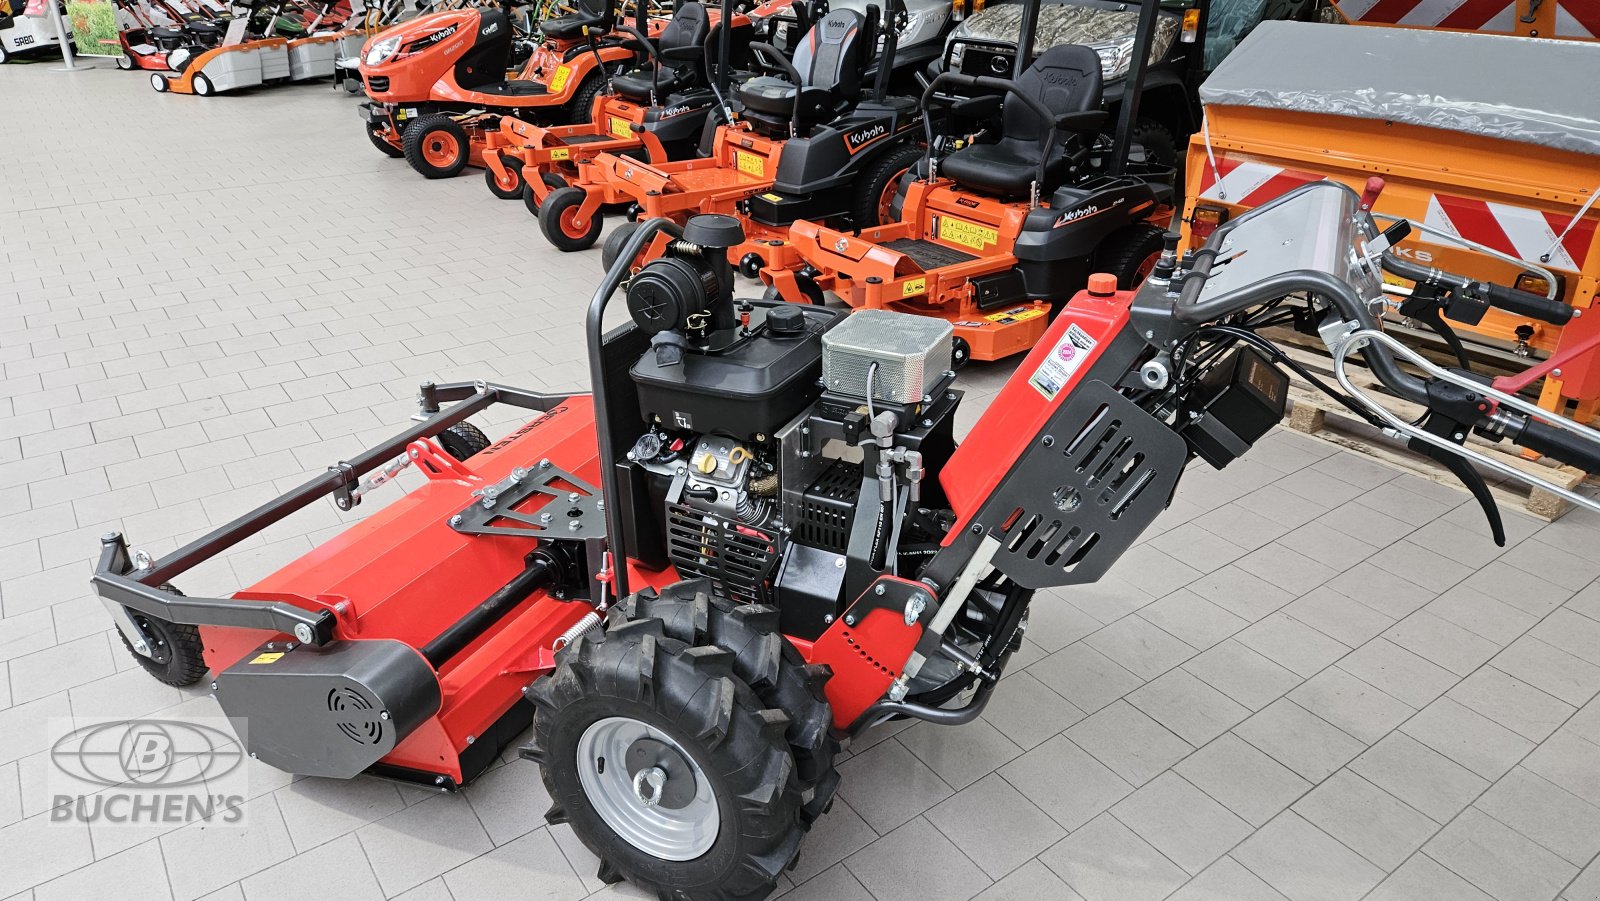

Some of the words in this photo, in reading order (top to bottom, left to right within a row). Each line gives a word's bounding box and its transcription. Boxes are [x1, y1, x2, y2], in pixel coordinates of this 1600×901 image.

[14, 35, 35, 46] SABO
[430, 26, 456, 42] Kubota
[1044, 72, 1078, 87] Kubota
[666, 105, 690, 116] Kubota
[851, 125, 884, 144] Kubota
[1063, 205, 1098, 221] Kubota
